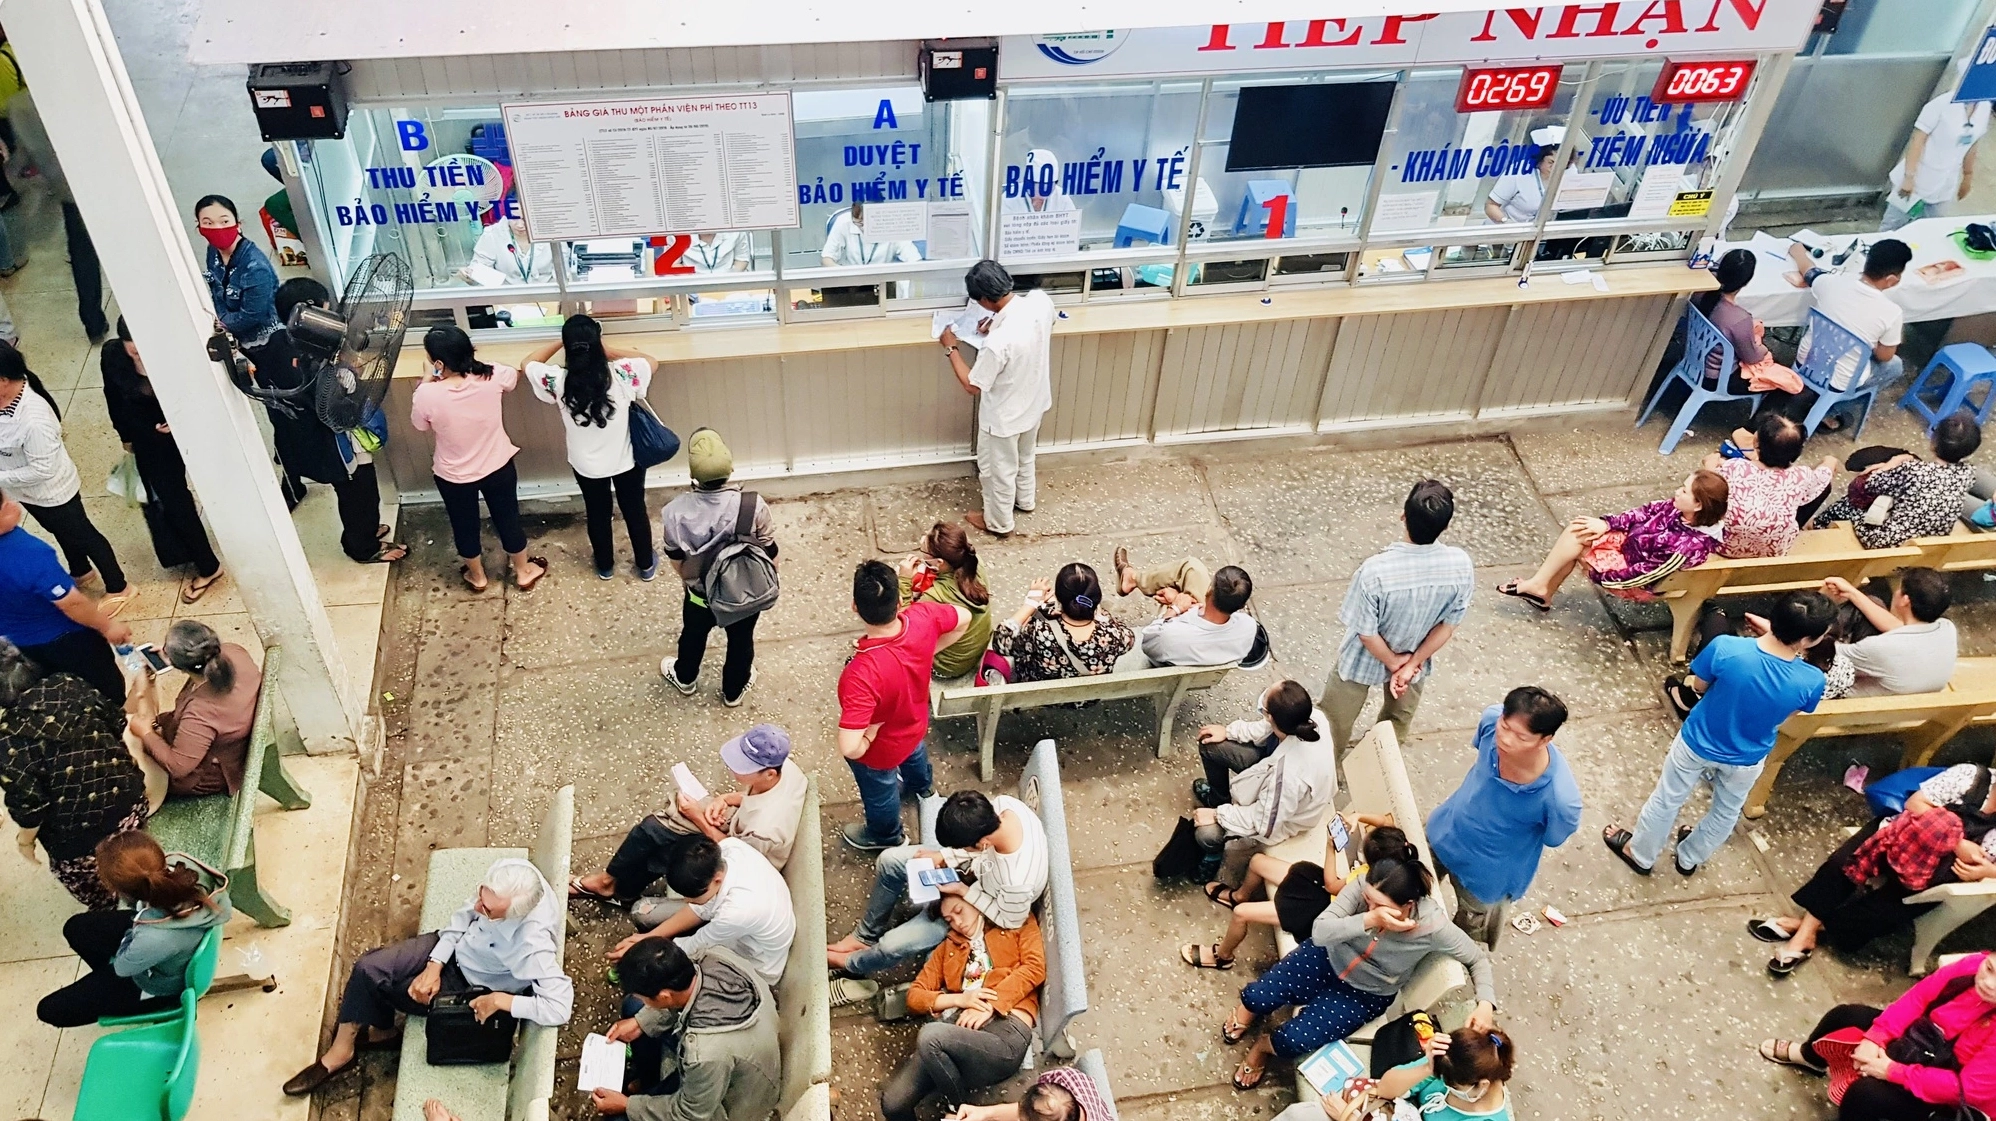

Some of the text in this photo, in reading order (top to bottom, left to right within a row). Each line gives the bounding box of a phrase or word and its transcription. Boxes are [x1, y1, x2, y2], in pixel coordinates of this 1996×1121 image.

[1467, 72, 1550, 104] 0269
[1667, 67, 1743, 95] 0063
[564, 107, 590, 118] BẢNG
[611, 108, 628, 116] THU
[630, 105, 648, 118] MỘT
[677, 103, 698, 113] VIỆN
[700, 102, 713, 111] PHÍ
[715, 102, 737, 111] THEO
[739, 101, 758, 110] TT13
[873, 99, 898, 129] A
[397, 120, 429, 151] B
[1585, 130, 1646, 168] TIÊM
[844, 140, 921, 170] DUYỆT
[1401, 143, 1473, 183] KHÁM
[1475, 139, 1541, 178] CÔNG
[366, 158, 485, 189] THU TIỀN
[799, 170, 964, 205] BẢO HIỂM Y TẾ
[1006, 146, 1189, 198] BẢO HIỂM Y TẾ
[336, 197, 388, 226] BẢO
[395, 193, 459, 226] HIỂM
[465, 201, 479, 221] Y
[1262, 195, 1289, 239] 1
[650, 235, 696, 275] 2
